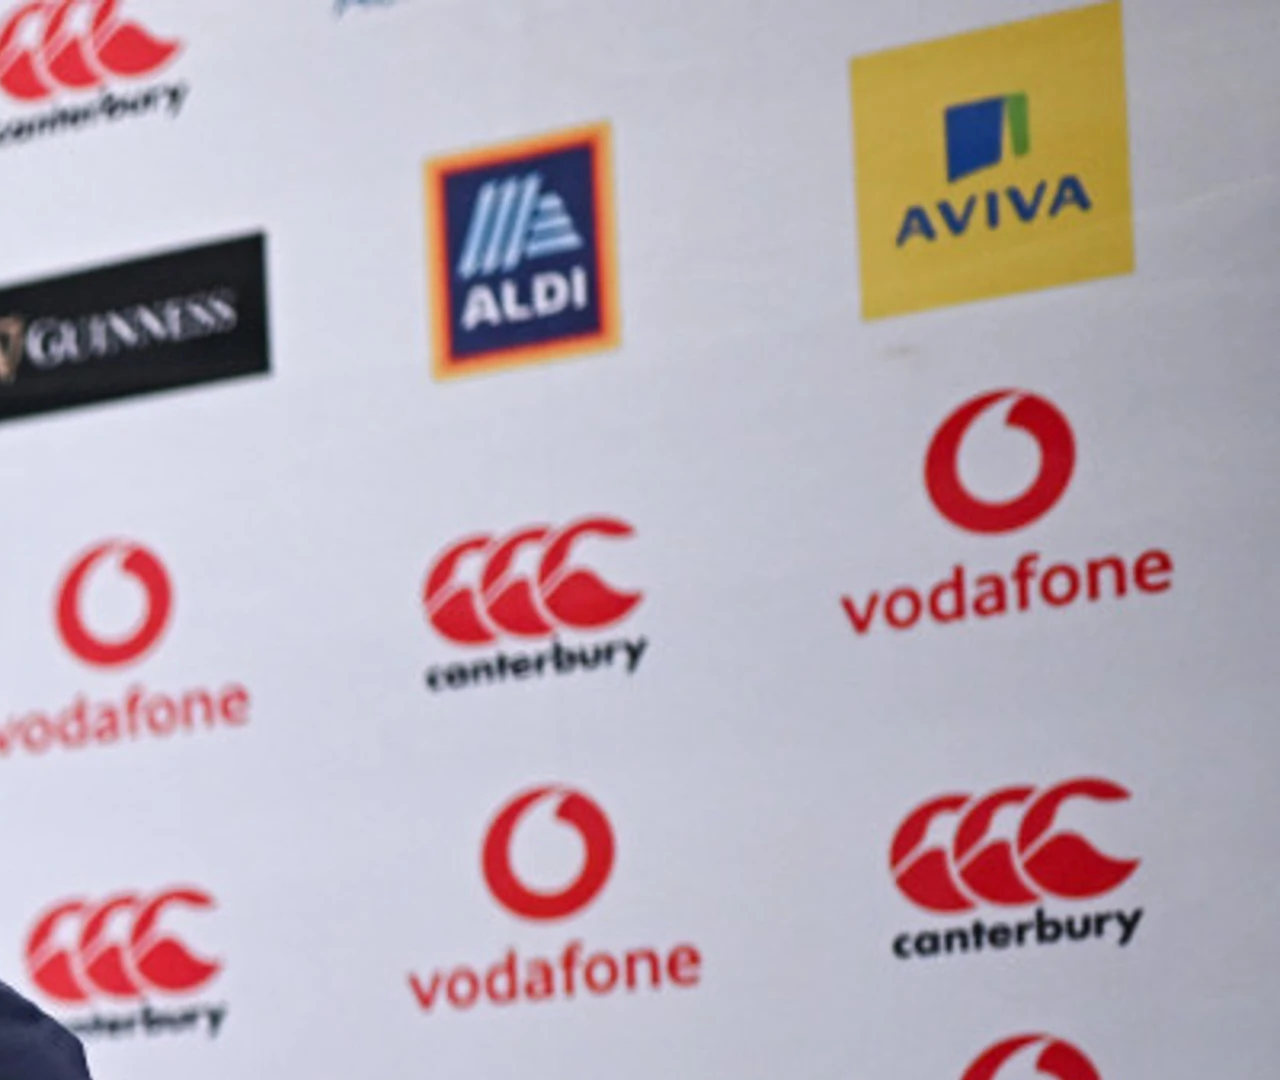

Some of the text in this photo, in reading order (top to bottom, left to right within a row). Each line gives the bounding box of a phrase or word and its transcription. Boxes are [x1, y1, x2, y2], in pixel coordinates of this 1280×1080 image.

[896, 175, 1092, 246] AVIVA
[24, 292, 238, 368] GUINNESS
[461, 266, 589, 330] ALDI
[841, 549, 1174, 636] vodafone
[426, 636, 648, 692] canterbury
[892, 905, 1144, 960] canterbury
[408, 940, 702, 1014] vodafone
[68, 998, 228, 1037] nterbury
